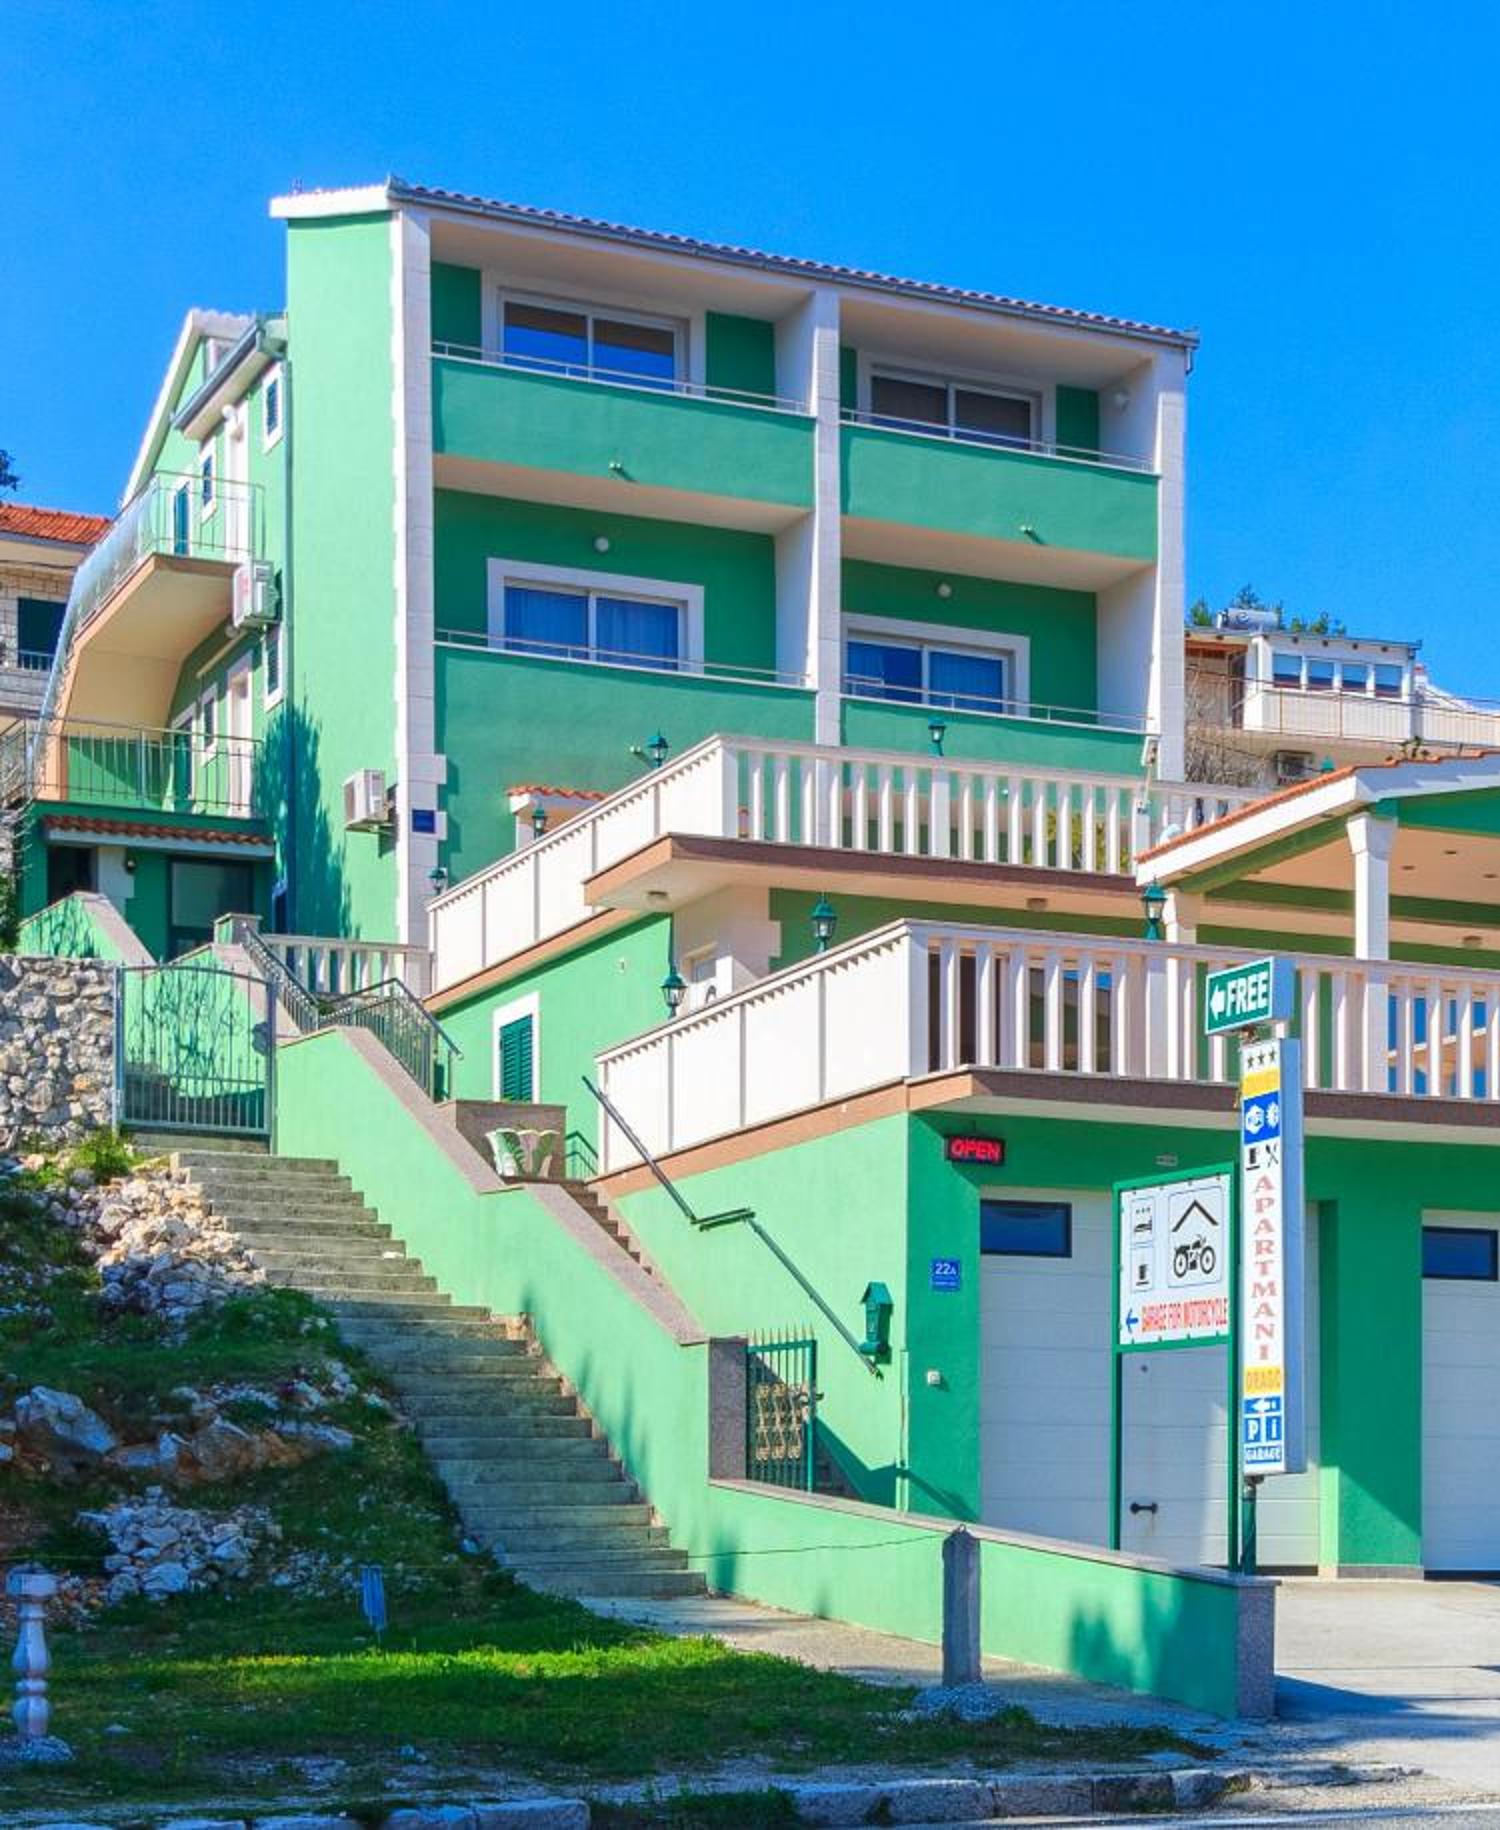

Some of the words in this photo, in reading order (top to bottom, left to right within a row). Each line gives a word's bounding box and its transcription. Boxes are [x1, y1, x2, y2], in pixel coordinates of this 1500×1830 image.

[1225, 970, 1268, 1019] FREE
[951, 1138, 999, 1161] OPEN
[1251, 1174, 1277, 1360] APARTMANI
[1247, 1418, 1259, 1441] P
